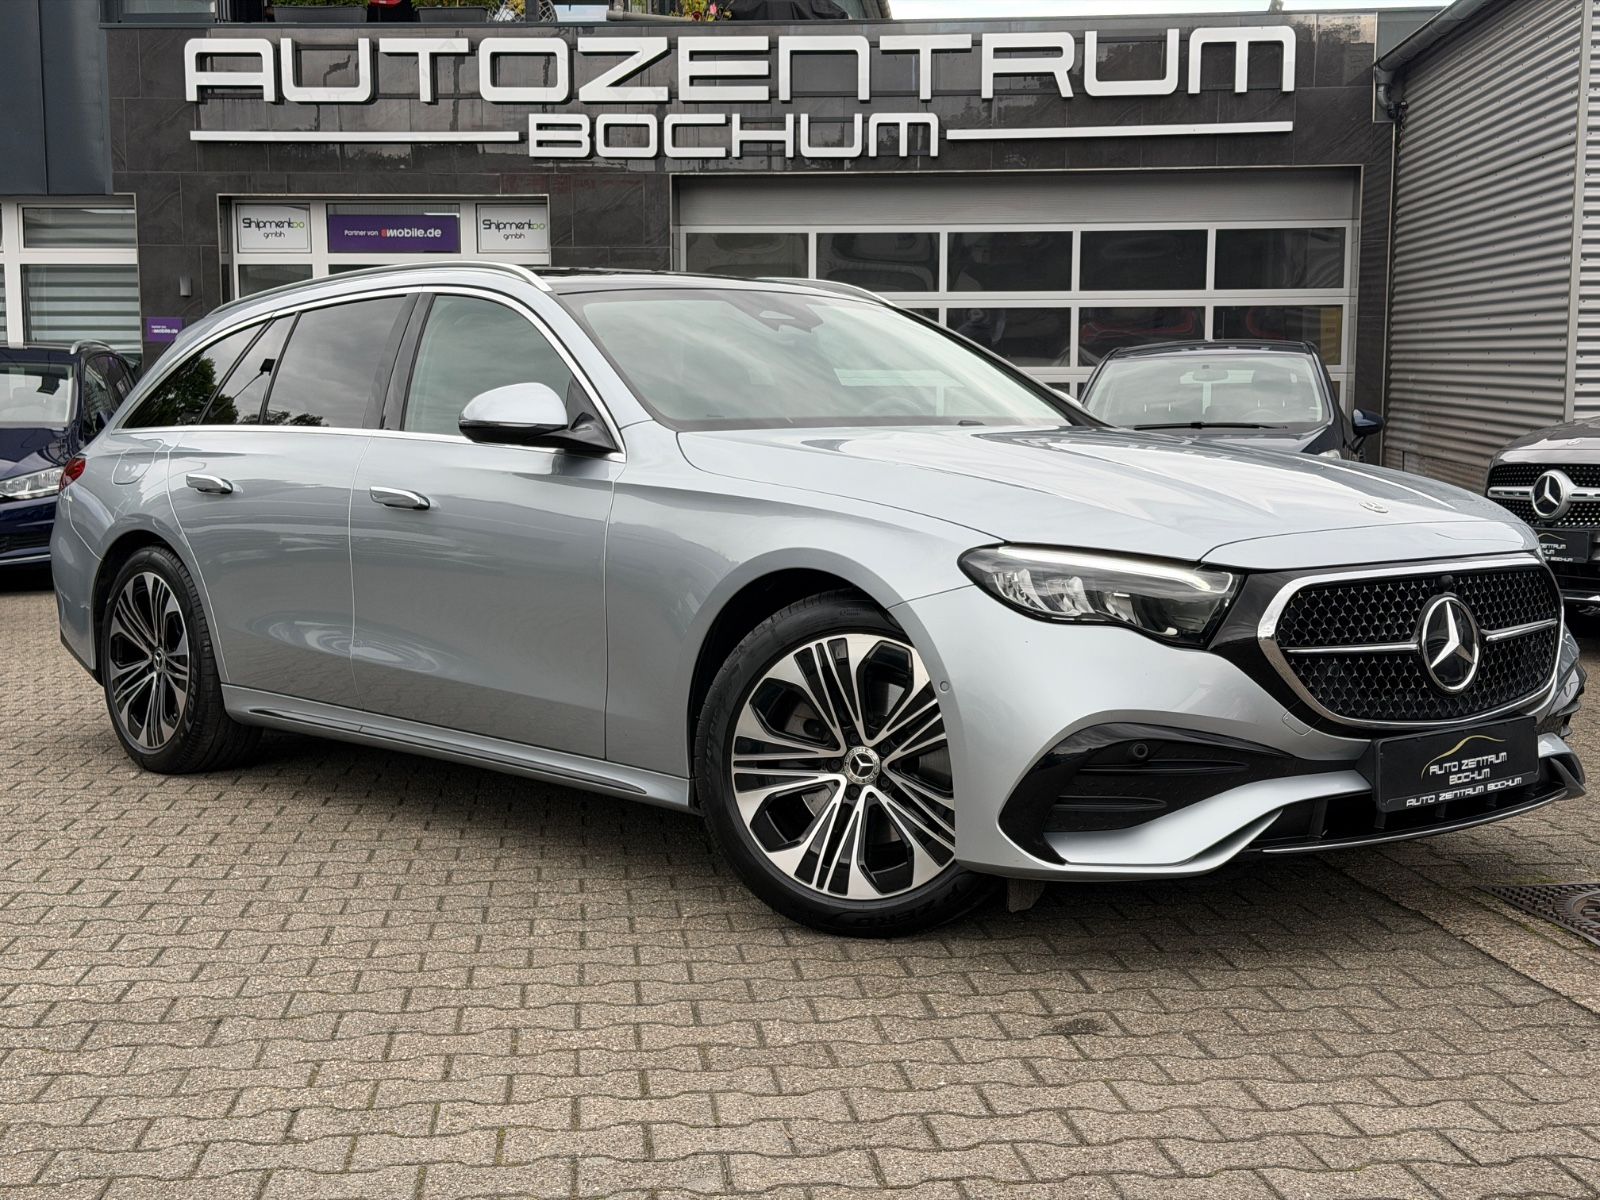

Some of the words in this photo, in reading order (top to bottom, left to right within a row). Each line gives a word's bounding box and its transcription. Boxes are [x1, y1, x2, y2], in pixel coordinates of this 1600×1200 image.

[184, 26, 1296, 102] AUTOZENTRUM
[528, 112, 938, 158] BOCHUM
[344, 228, 366, 236] Partner
[386, 228, 442, 237] mobile.de
[1429, 761, 1459, 776] AUTO
[1461, 752, 1507, 769] ZENTRUM
[1449, 768, 1491, 785] BOCHUM
[1406, 794, 1436, 807] AUTO
[1439, 785, 1484, 800] ZENTRUM
[1487, 777, 1522, 790] BOCHUM
